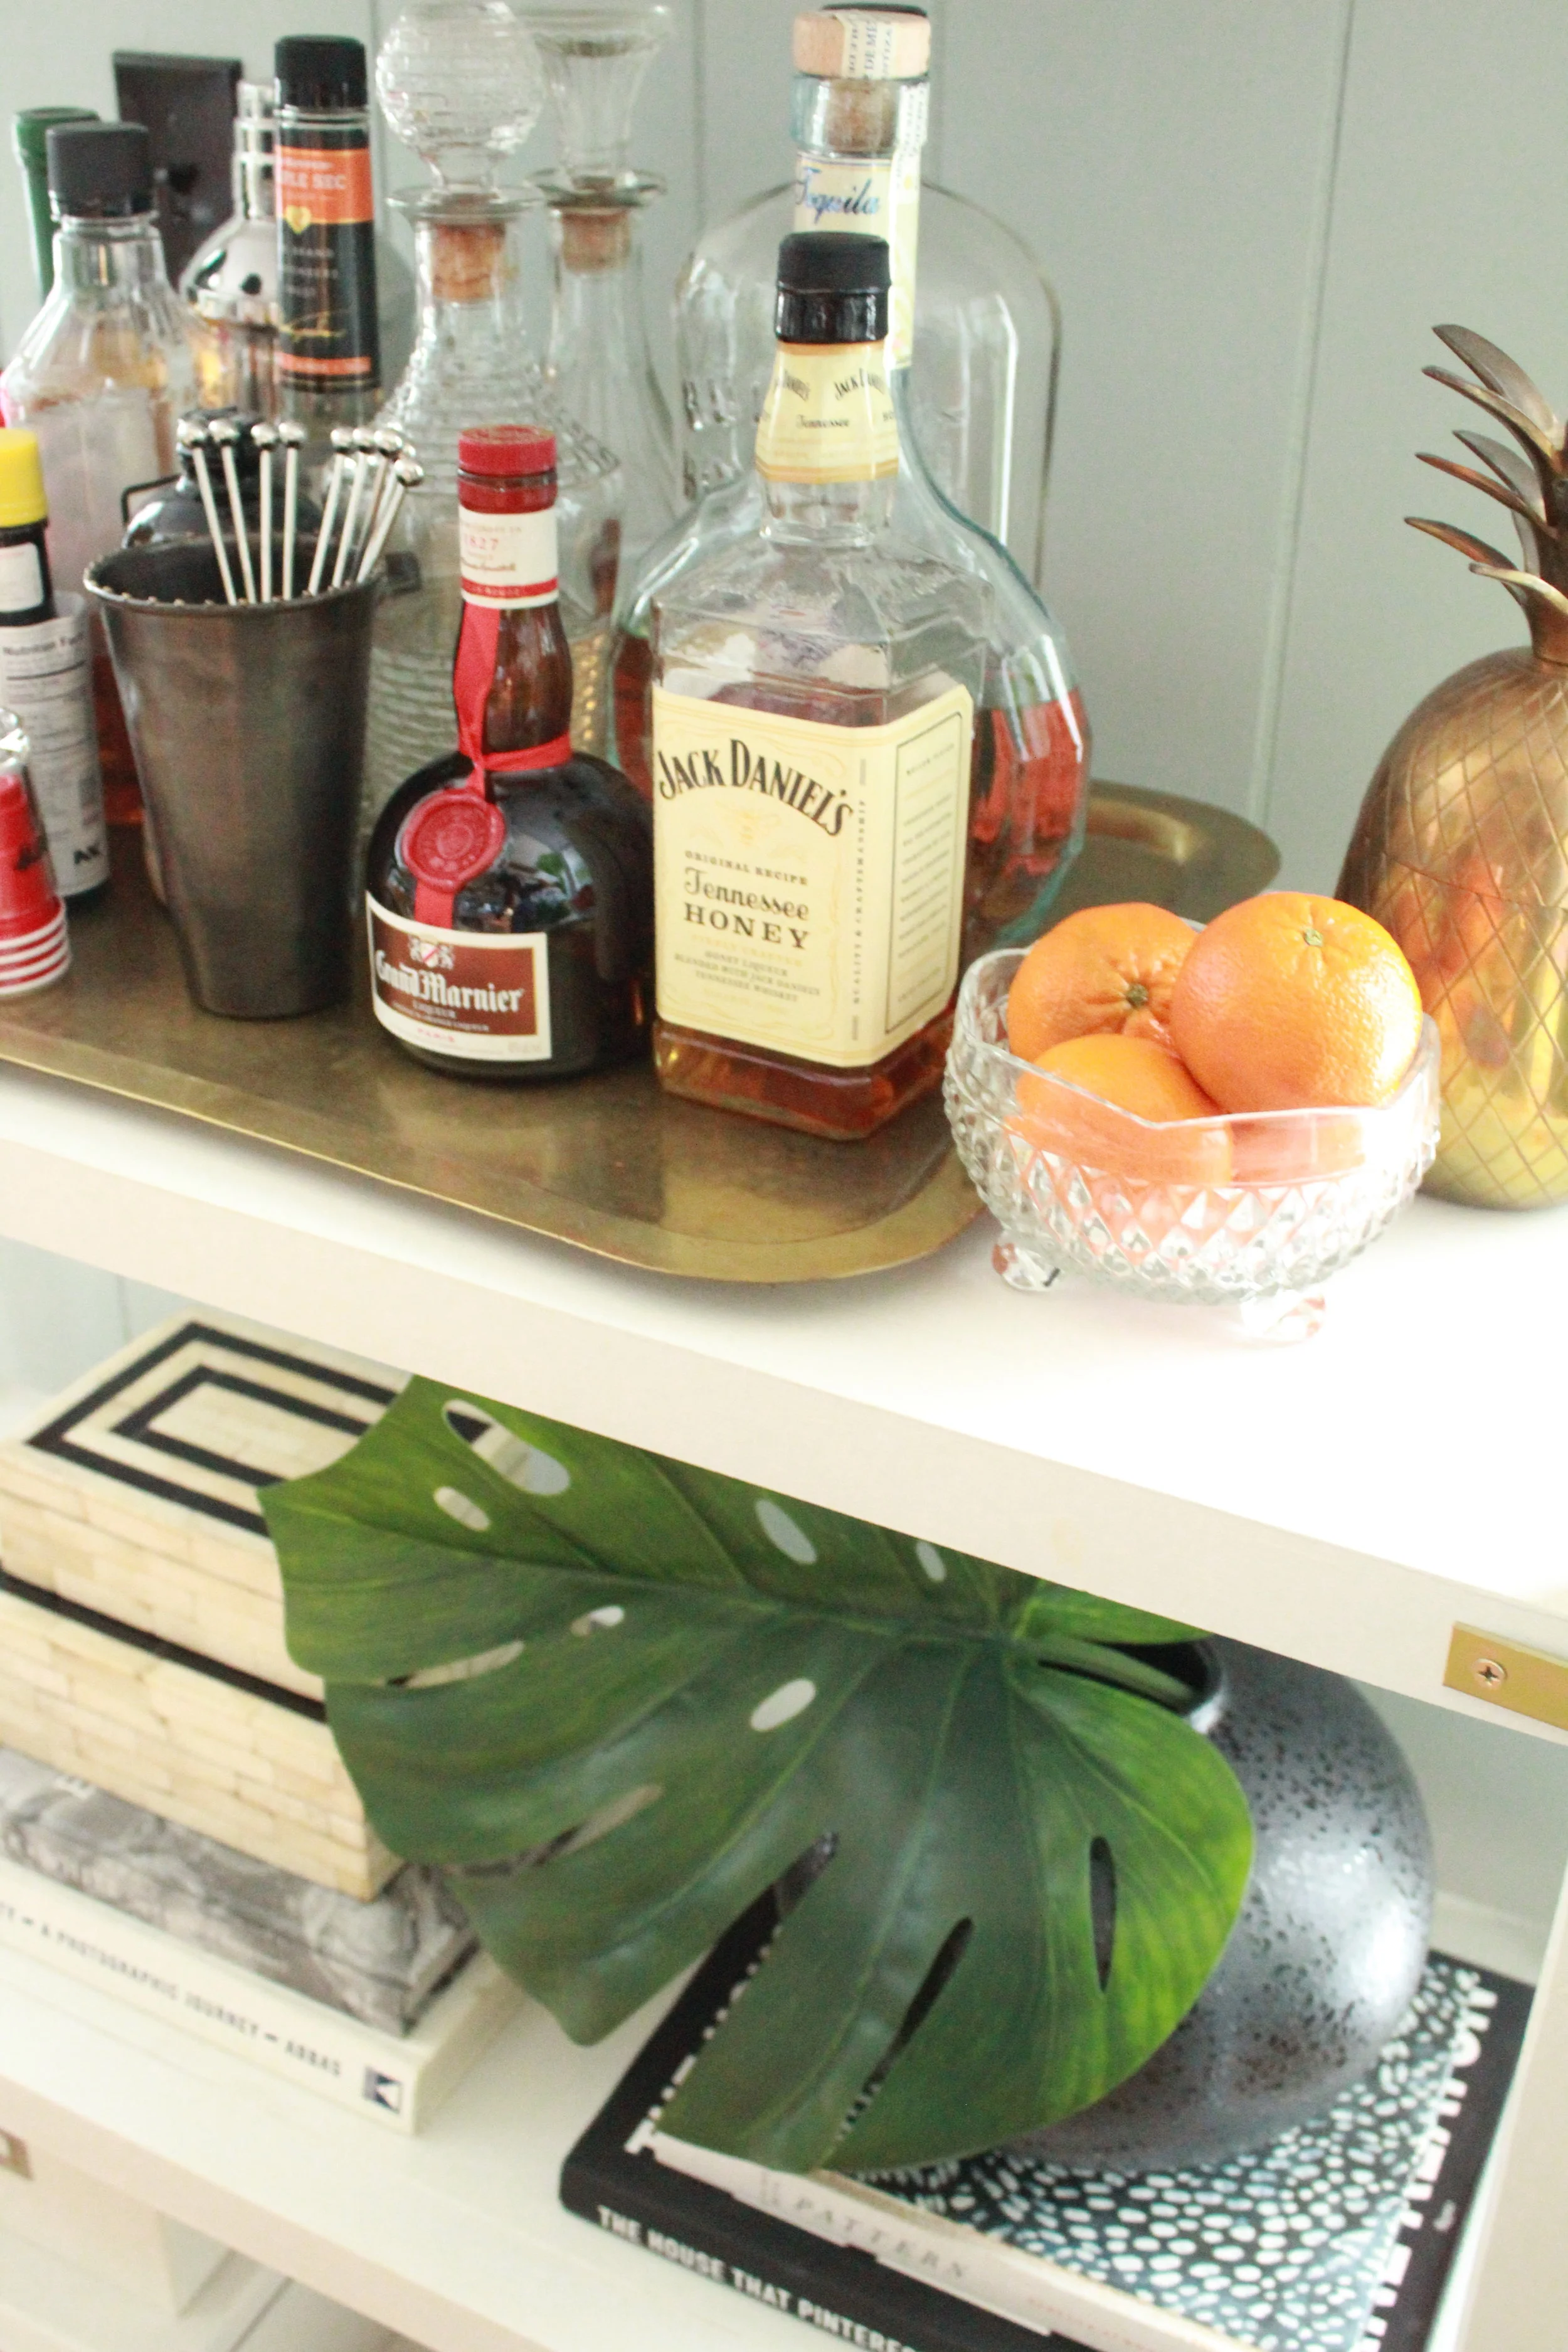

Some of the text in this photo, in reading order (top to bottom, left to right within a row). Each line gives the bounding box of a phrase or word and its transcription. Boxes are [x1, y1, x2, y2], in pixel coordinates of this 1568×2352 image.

[795, 166, 881, 224] Tequila
[658, 749, 726, 800] JACK
[729, 738, 854, 837] DANIEL'S
[684, 866, 810, 921] Tennessee
[685, 850, 808, 886] ORIGINAL RECIPE
[684, 902, 810, 951] HONEY
[419, 970, 525, 1014] Marnier
[795, 2197, 964, 2280] PATTERN
[597, 2204, 917, 2352] THE HOUSE THAT PINTERE
